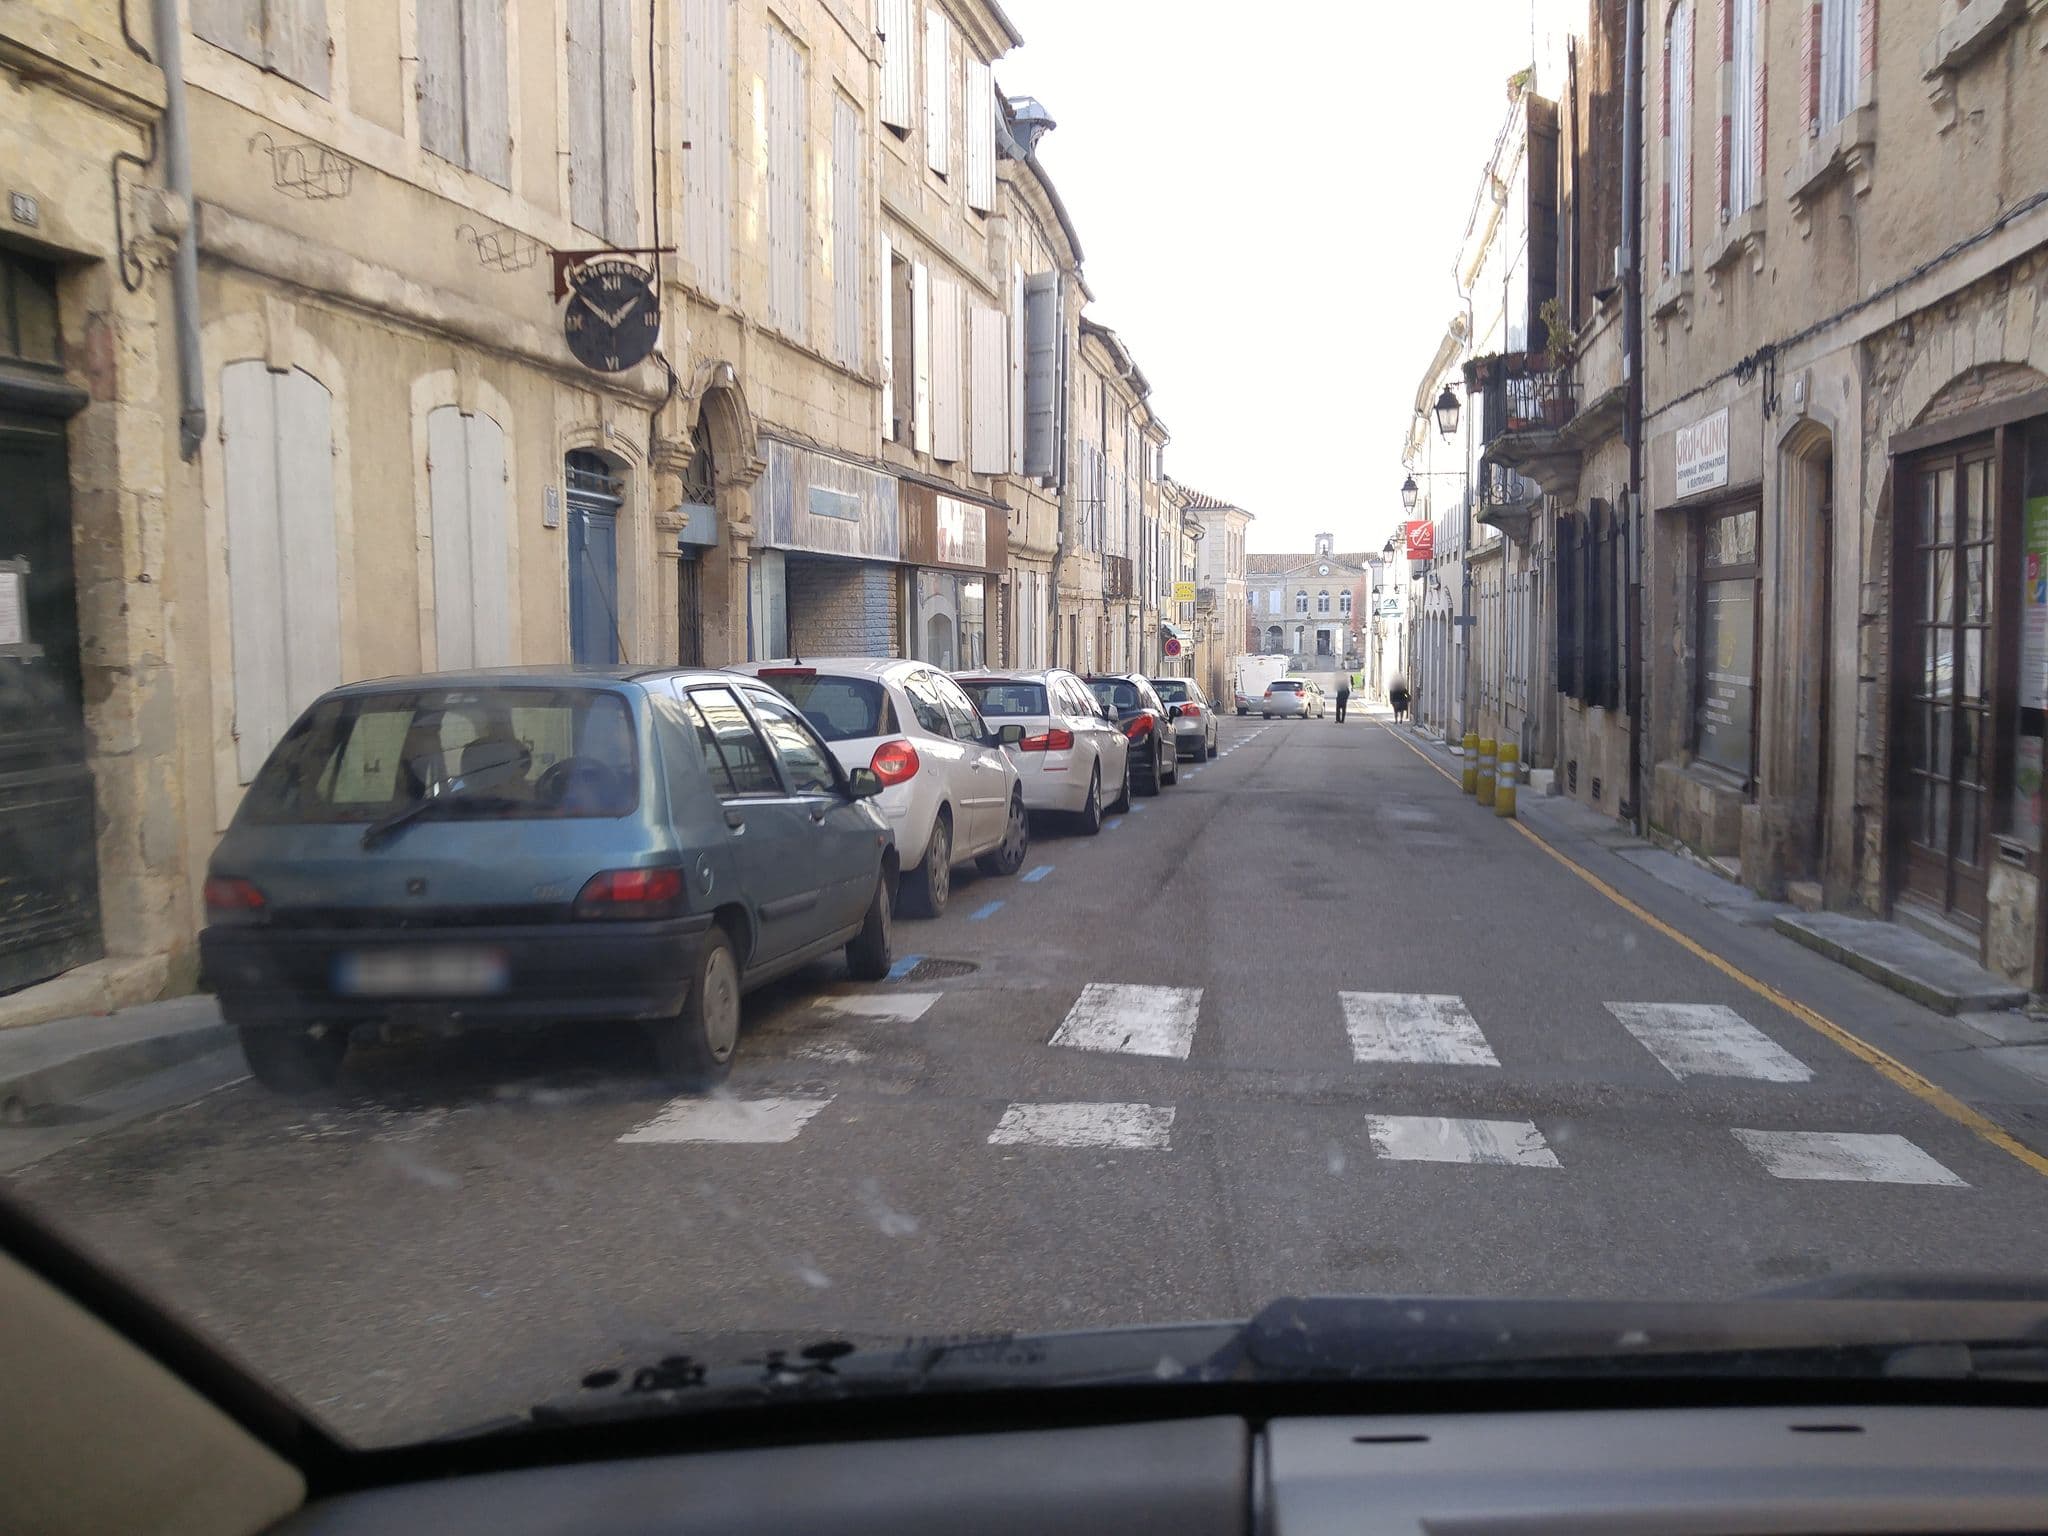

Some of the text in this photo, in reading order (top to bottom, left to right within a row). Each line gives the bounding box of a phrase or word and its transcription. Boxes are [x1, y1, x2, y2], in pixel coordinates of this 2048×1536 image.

[576, 262, 649, 284] L'HORLOGE
[601, 275, 621, 291] XII
[644, 311, 657, 327] III
[605, 355, 620, 371] VI
[1677, 415, 1726, 465] ORDI-CLINIC
